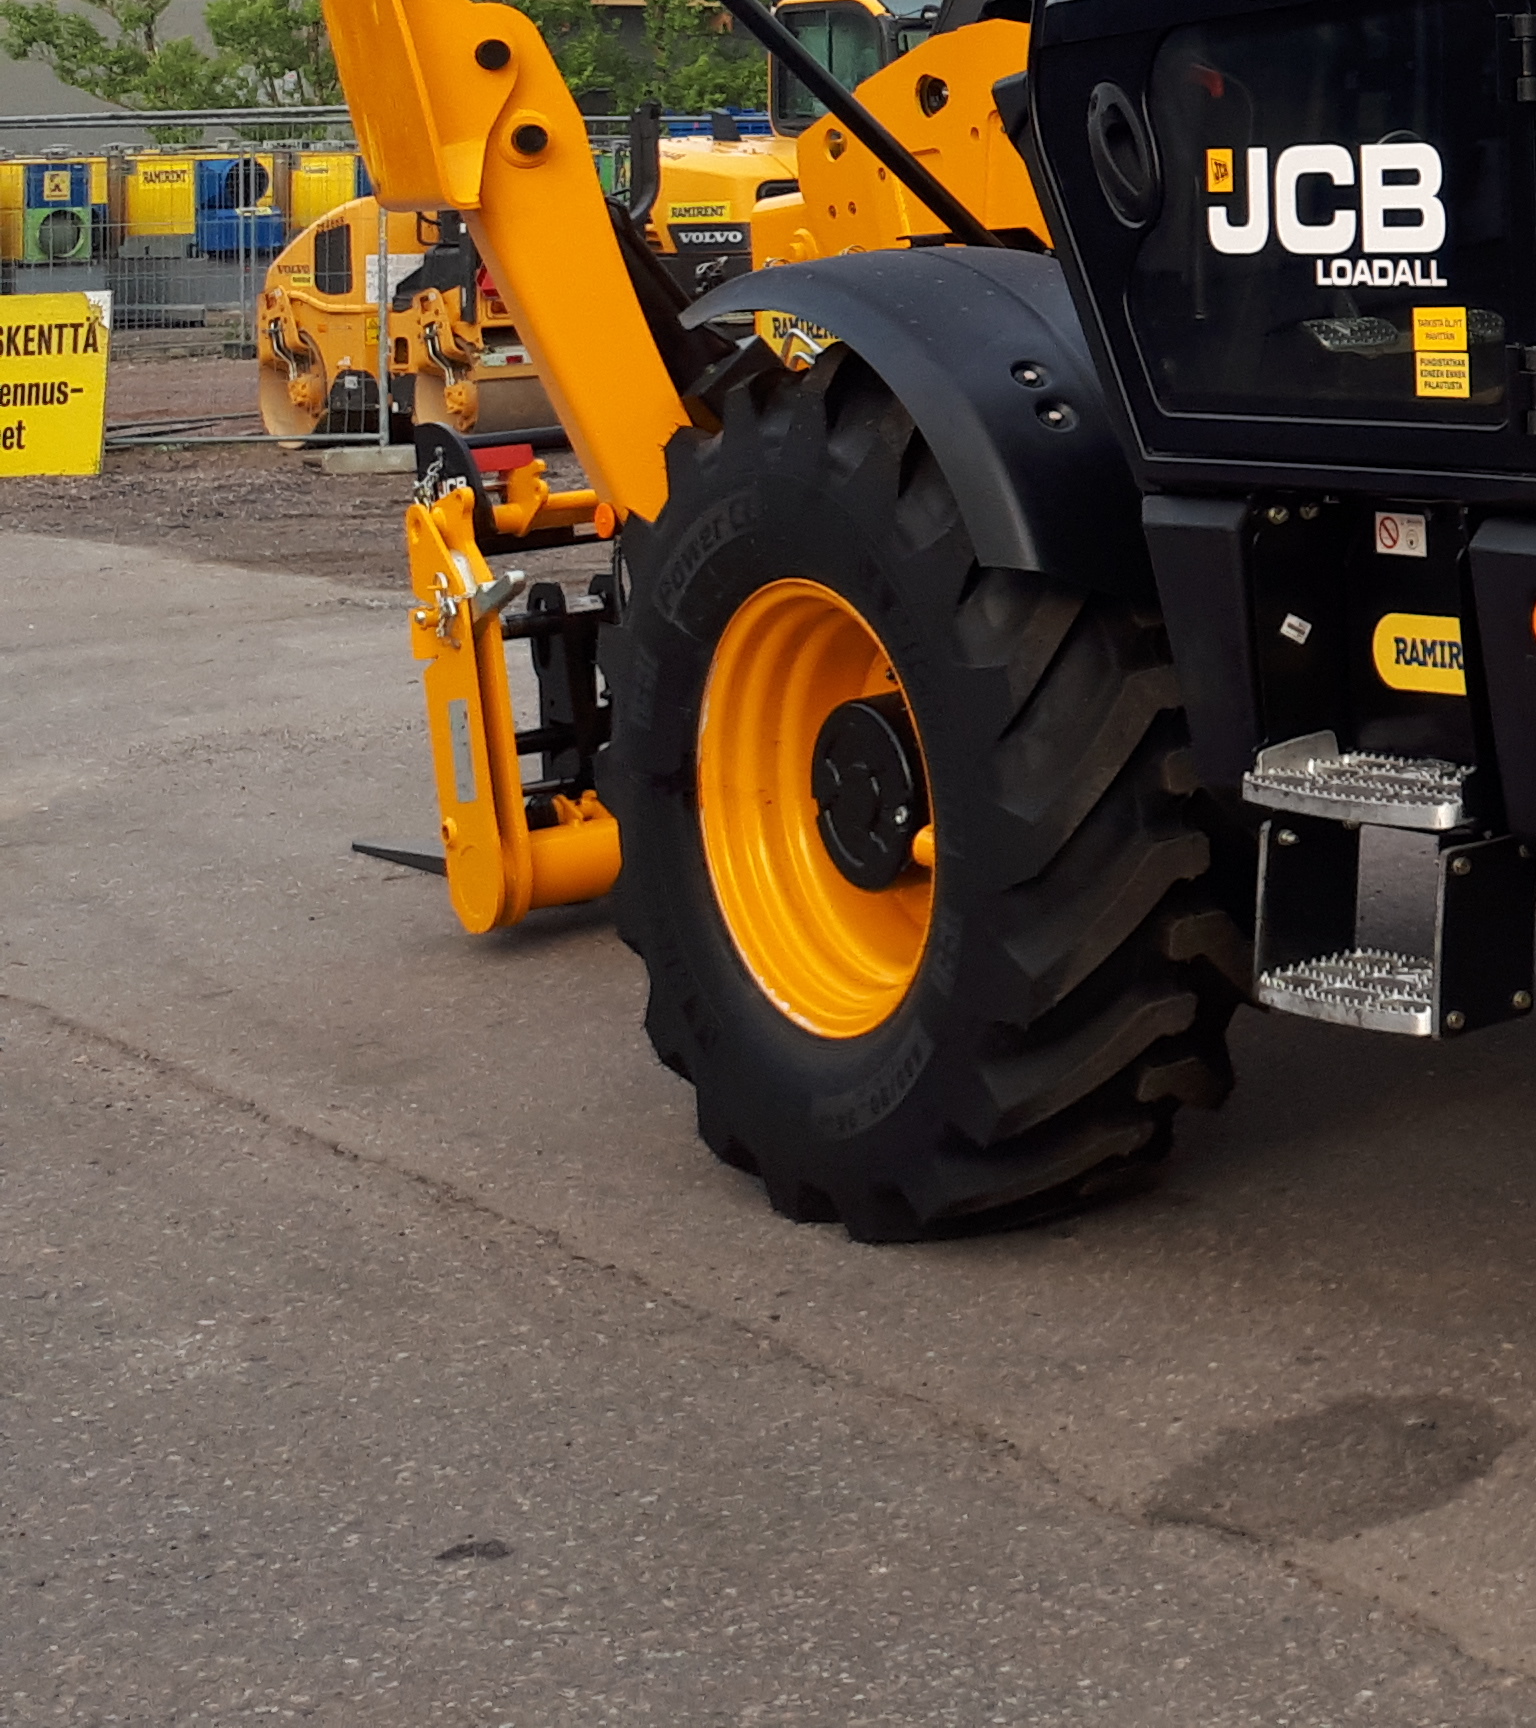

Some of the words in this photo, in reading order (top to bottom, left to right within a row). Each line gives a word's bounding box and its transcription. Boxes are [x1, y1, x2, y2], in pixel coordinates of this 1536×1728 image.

[671, 205, 725, 218] RAMIRENT
[1208, 142, 1446, 254] JCB
[678, 231, 742, 243] VOLVO
[1316, 259, 1448, 287] LOADALL
[0, 317, 99, 357] KENTTÄ
